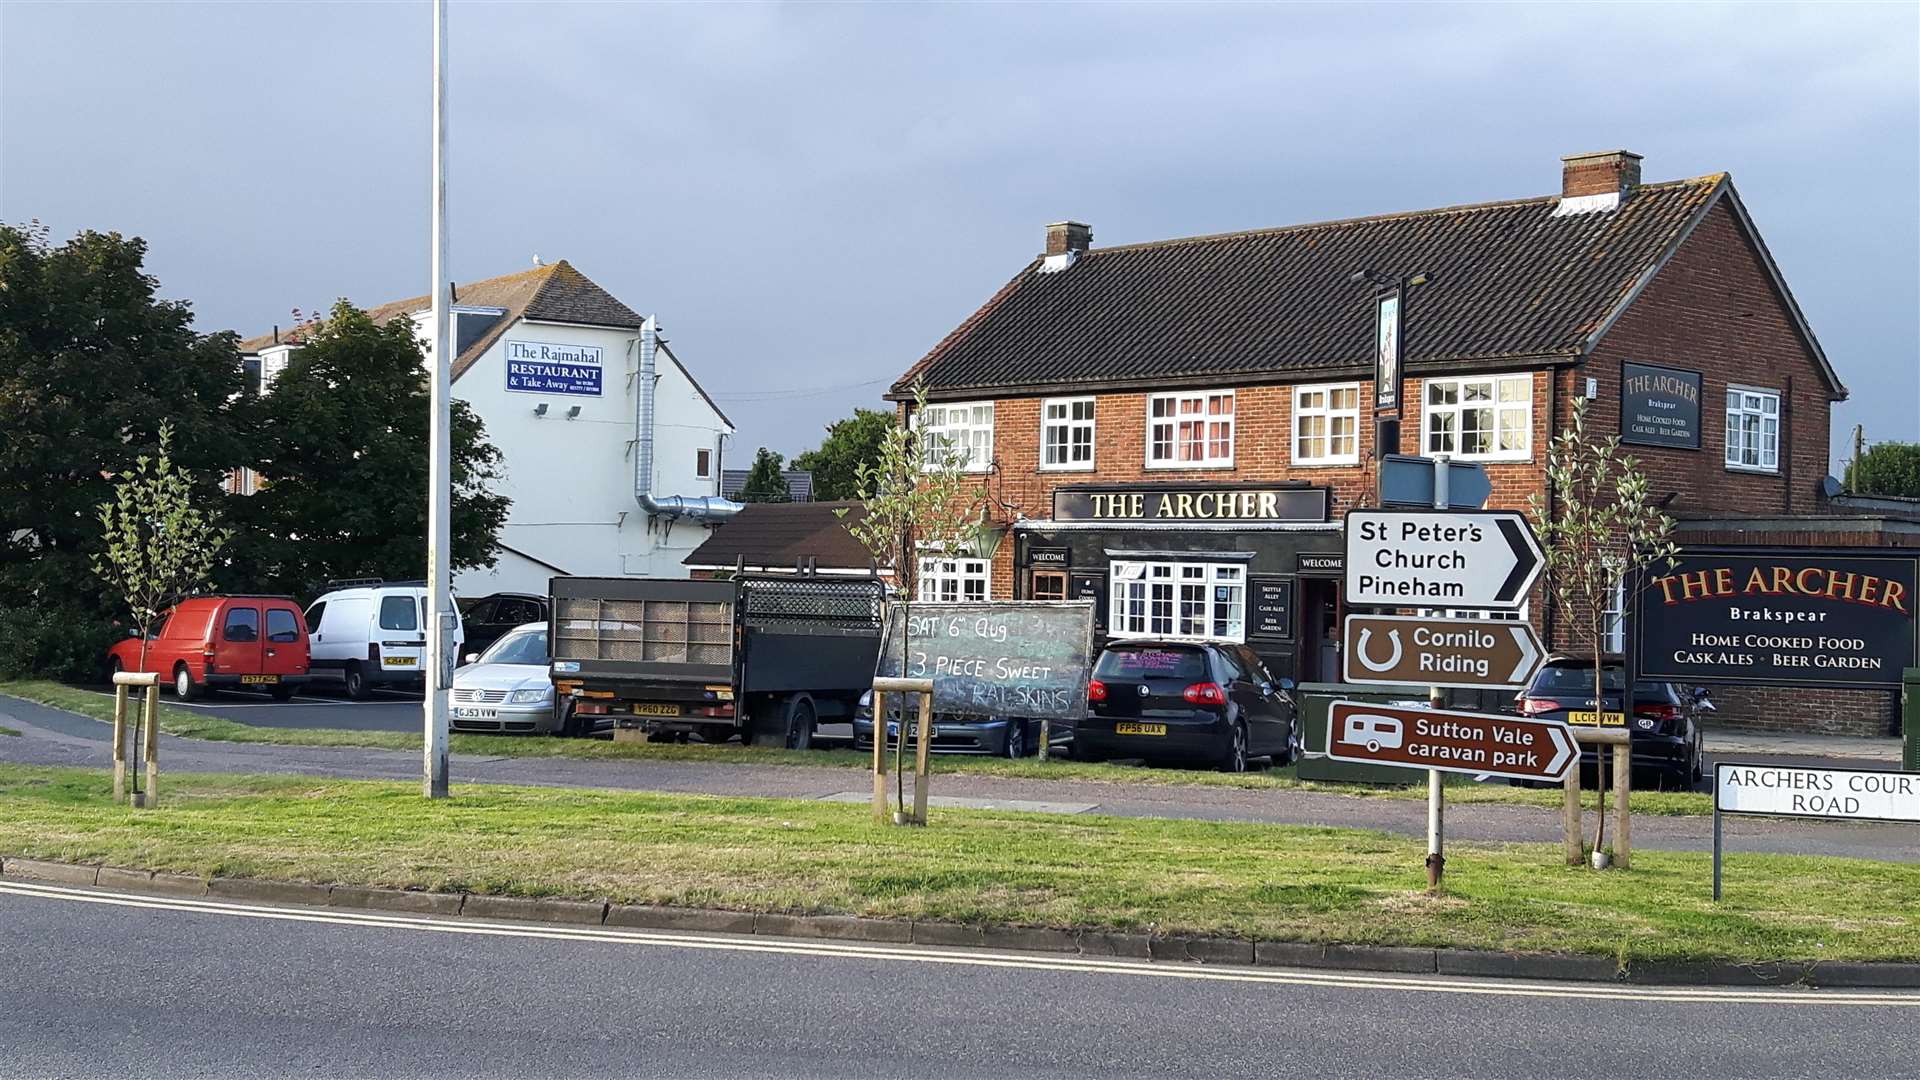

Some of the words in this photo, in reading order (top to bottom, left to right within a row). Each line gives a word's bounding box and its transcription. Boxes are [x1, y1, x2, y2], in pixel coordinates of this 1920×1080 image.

[510, 343, 537, 359] The
[541, 346, 600, 365] Rajmahal
[509, 377, 519, 386] &
[511, 363, 599, 379] RESTAURANT
[1626, 375, 1650, 395] THE
[1652, 375, 1697, 405] ARCHER
[1090, 493, 1145, 518] THE
[1156, 492, 1279, 518] ARCHER
[1360, 521, 1388, 541] St
[1402, 522, 1482, 542] Peter's
[1032, 553, 1065, 561] WELCOME
[1302, 559, 1343, 568] WELCOME
[1375, 549, 1466, 569] Church
[1359, 576, 1464, 597] Pineham
[1653, 568, 1734, 605] THE
[1743, 566, 1908, 614] ARCHER
[1730, 607, 1827, 623] Brakspear
[907, 616, 940, 637] SAT
[1413, 627, 1495, 649] Cornilo
[1692, 634, 1740, 647] HOME
[1745, 634, 1813, 649] COOKED
[1818, 636, 1864, 650] FOOD
[913, 652, 927, 676] 3
[936, 655, 986, 677] PIECE
[1419, 652, 1489, 677] Riding
[1674, 651, 1714, 664] CASK
[1717, 652, 1754, 665] ALES
[1772, 653, 1810, 667] BEER
[1814, 654, 1881, 669] GARDEN
[459, 708, 479, 717] GJ53
[1575, 713, 1597, 722] LC13
[1120, 723, 1143, 733] FP56
[1144, 724, 1162, 734] UAX
[1415, 719, 1483, 741] Sutton
[1492, 726, 1534, 746] Vale
[1408, 743, 1485, 762] caravan
[1492, 748, 1538, 768] park
[1727, 769, 1833, 791] ARCHERS
[1792, 794, 1860, 814] ROAD
